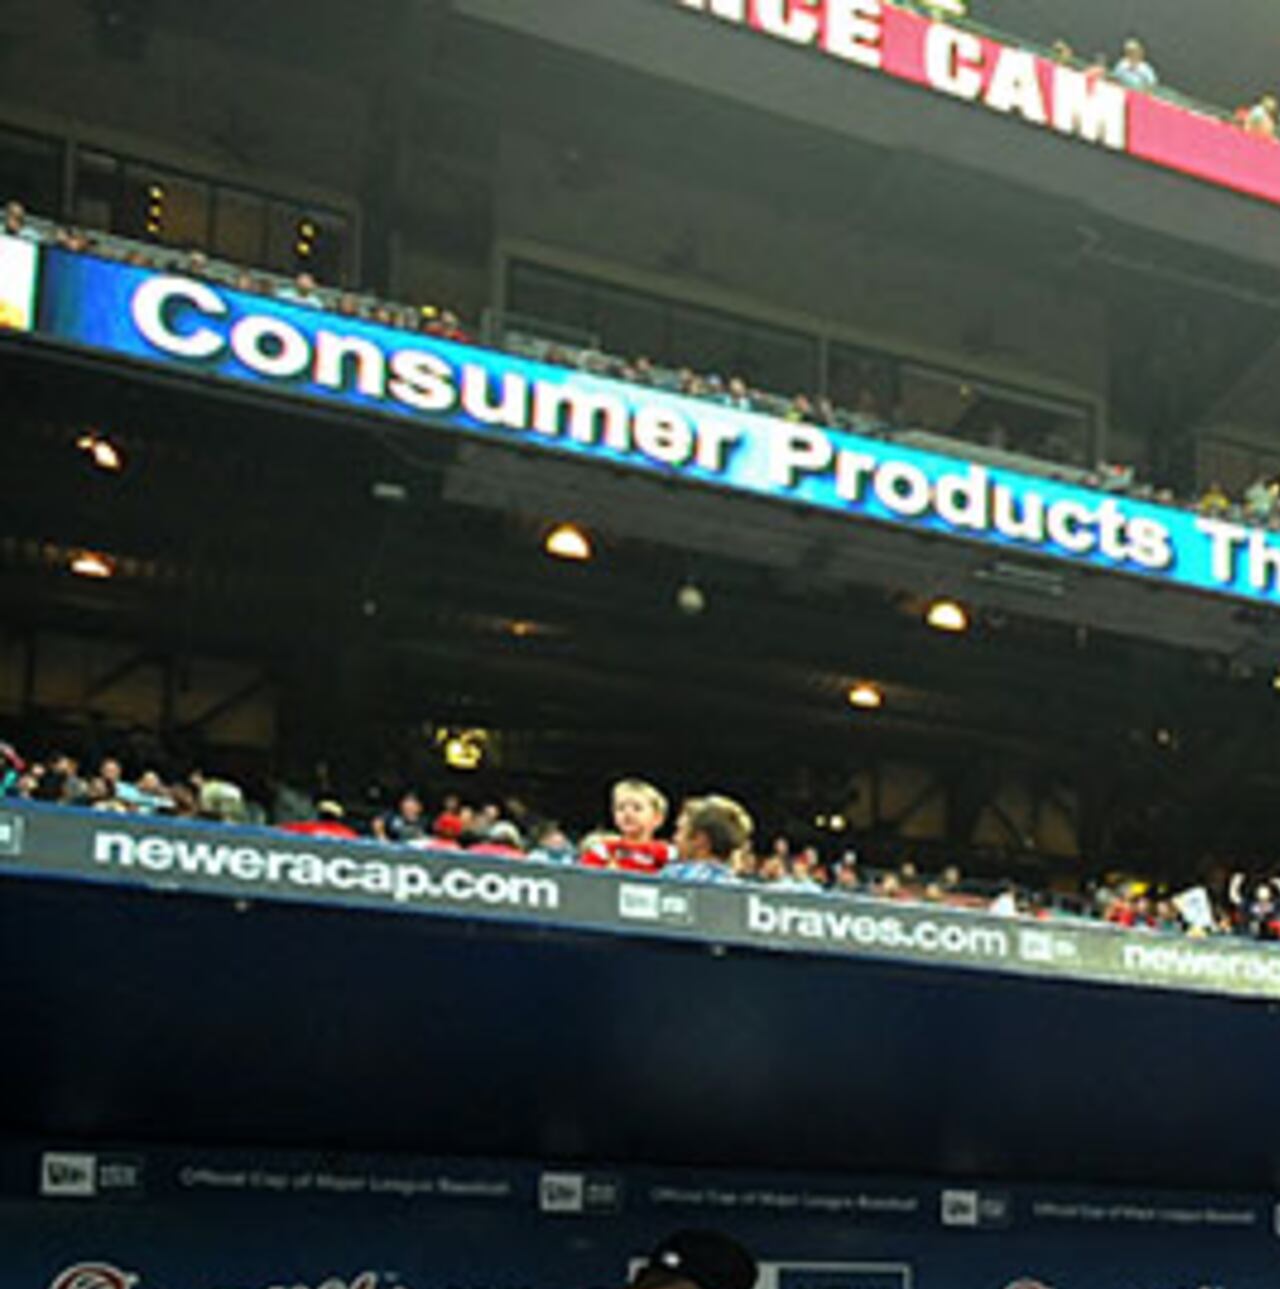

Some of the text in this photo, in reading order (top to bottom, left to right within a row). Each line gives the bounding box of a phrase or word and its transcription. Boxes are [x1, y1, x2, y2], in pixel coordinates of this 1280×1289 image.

[923, 20, 1127, 151] CAM
[131, 274, 742, 471] Consumer
[771, 424, 1174, 569] Products
[95, 828, 558, 906] neweracap.com
[748, 885, 1006, 958] braves.com
